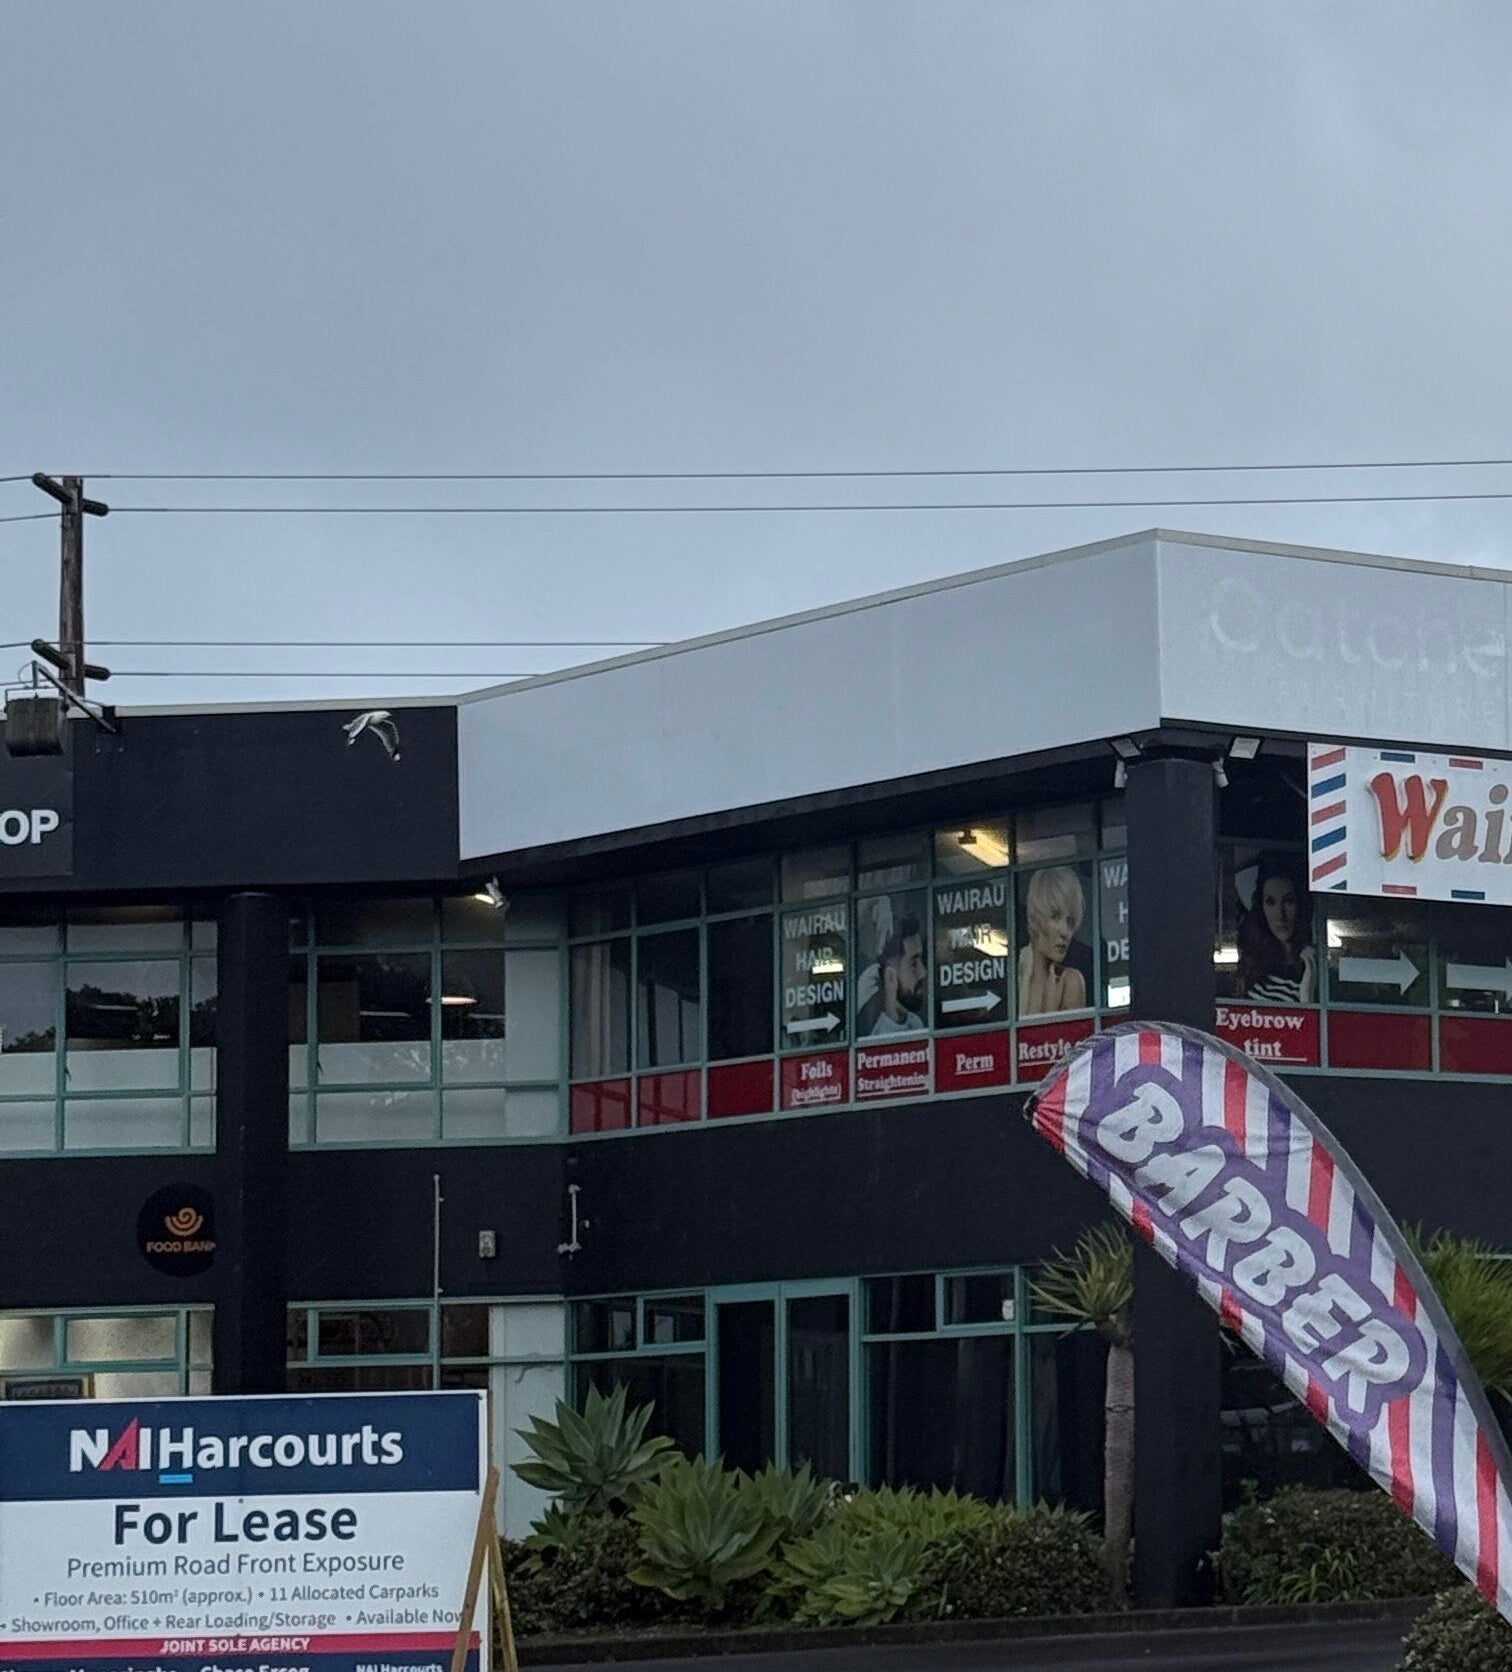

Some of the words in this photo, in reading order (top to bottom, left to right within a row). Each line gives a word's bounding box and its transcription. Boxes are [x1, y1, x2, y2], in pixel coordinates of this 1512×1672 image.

[936, 884, 1006, 915] WAIRAU
[783, 911, 847, 940] WAIRAU
[940, 957, 1005, 987] DESIGN
[784, 981, 845, 1008] DESIGN
[1216, 1007, 1304, 1031] Eyebrow
[1243, 1037, 1283, 1057] tint
[801, 1060, 833, 1082] Foils
[956, 1053, 994, 1072] Perm
[146, 1241, 182, 1253] FOOD
[1096, 1081, 1411, 1415] BARBER
[114, 1504, 198, 1546] For
[214, 1501, 358, 1543] Lease
[67, 1556, 167, 1578] Premium
[174, 1554, 231, 1576] Road
[238, 1553, 297, 1574] Front
[302, 1552, 405, 1577] Exposure
[44, 1591, 83, 1607] Floor
[87, 1590, 128, 1606] Area:
[182, 1586, 253, 1607] (approx.)
[269, 1587, 287, 1601] 11
[291, 1584, 365, 1601] Allocated
[368, 1583, 440, 1602] Carparks
[11, 1616, 100, 1634] Showroom,
[103, 1614, 149, 1631] Office
[166, 1614, 201, 1630] Rear
[205, 1611, 336, 1631] Loading/Storage
[356, 1608, 428, 1625] Available
[160, 1639, 206, 1654] JOINT
[208, 1638, 247, 1653] SOLE
[249, 1637, 311, 1652] AGENCY
